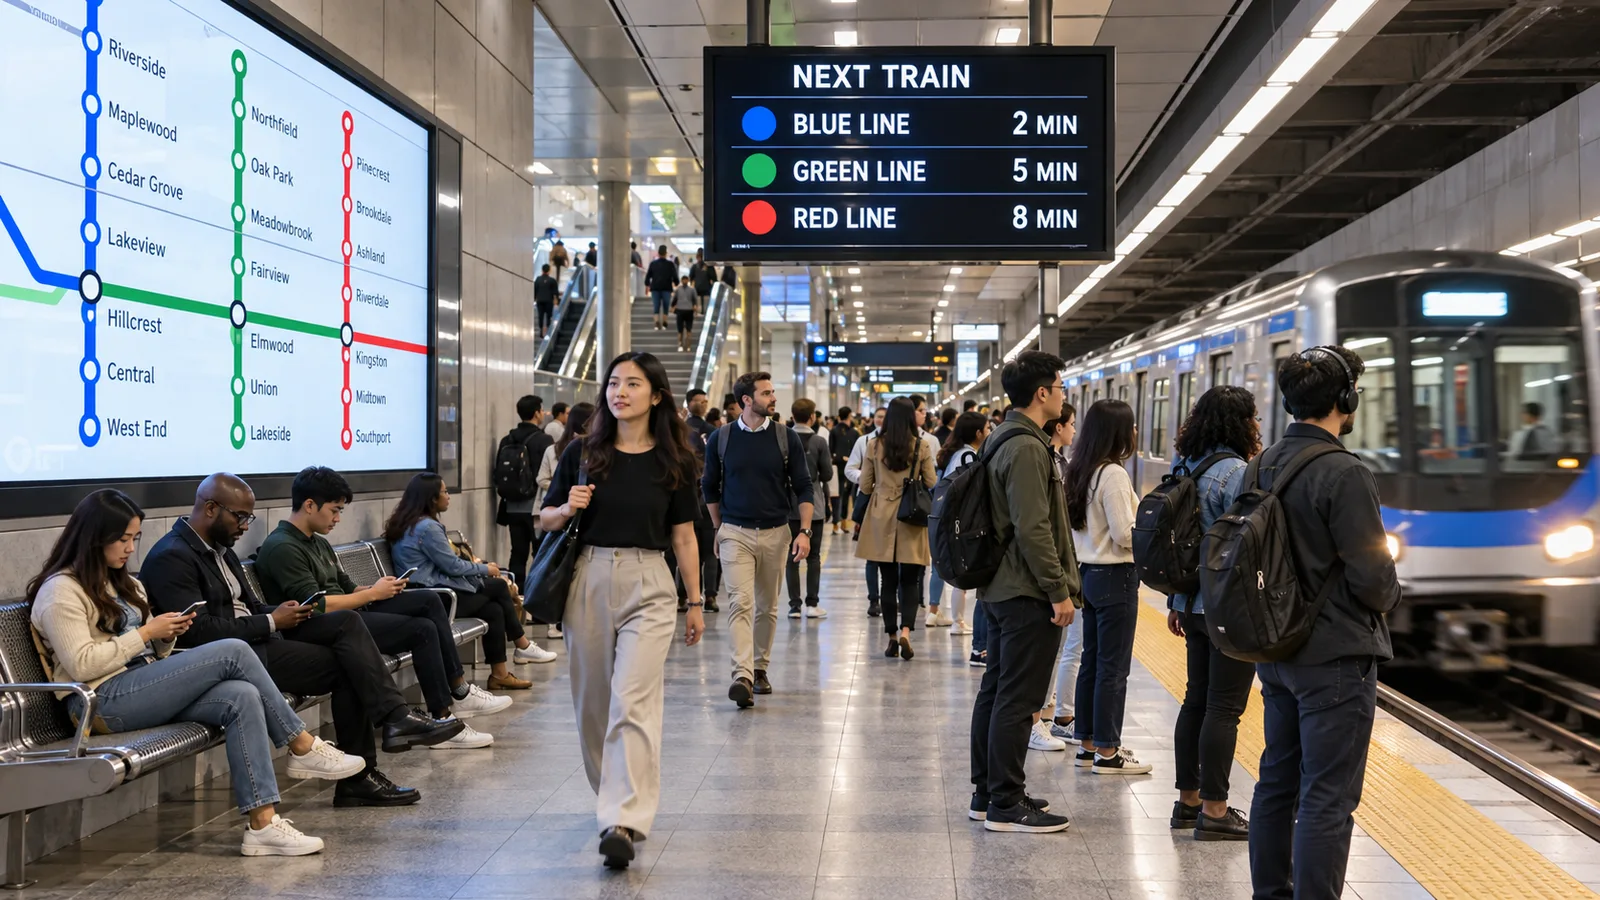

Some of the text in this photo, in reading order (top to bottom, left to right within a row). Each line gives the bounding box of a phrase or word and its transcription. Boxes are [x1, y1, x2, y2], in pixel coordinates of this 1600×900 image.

[109, 38, 166, 80] Riverside
[793, 64, 970, 89] NEXT TRAIN
[108, 100, 177, 143] Maplewood
[251, 105, 298, 139] Northfield
[793, 110, 1077, 135] BLUE LINE 2 MIN
[108, 161, 183, 201] Cedar Grove
[251, 157, 294, 187] Oak Park
[356, 156, 390, 183] Pinecrest
[793, 157, 1077, 183] GREEN LINE 5 MIN
[251, 208, 313, 242] Meadowbrook
[356, 200, 392, 225] Brookdale
[793, 204, 1077, 230] RED LINE 8 MIN
[108, 226, 166, 258] Lakeview
[356, 244, 385, 265] Ashland
[251, 260, 290, 284] Fairview
[356, 288, 389, 309] Riverdale
[108, 308, 162, 334] Hillcrest
[251, 332, 294, 354] Elmwood
[107, 361, 155, 384] Central
[356, 350, 388, 370] Kingston
[250, 379, 278, 396] Union
[356, 389, 386, 405] Midtown
[106, 417, 167, 438] West End
[250, 425, 291, 442] Lakeside
[356, 429, 391, 446] Southport
